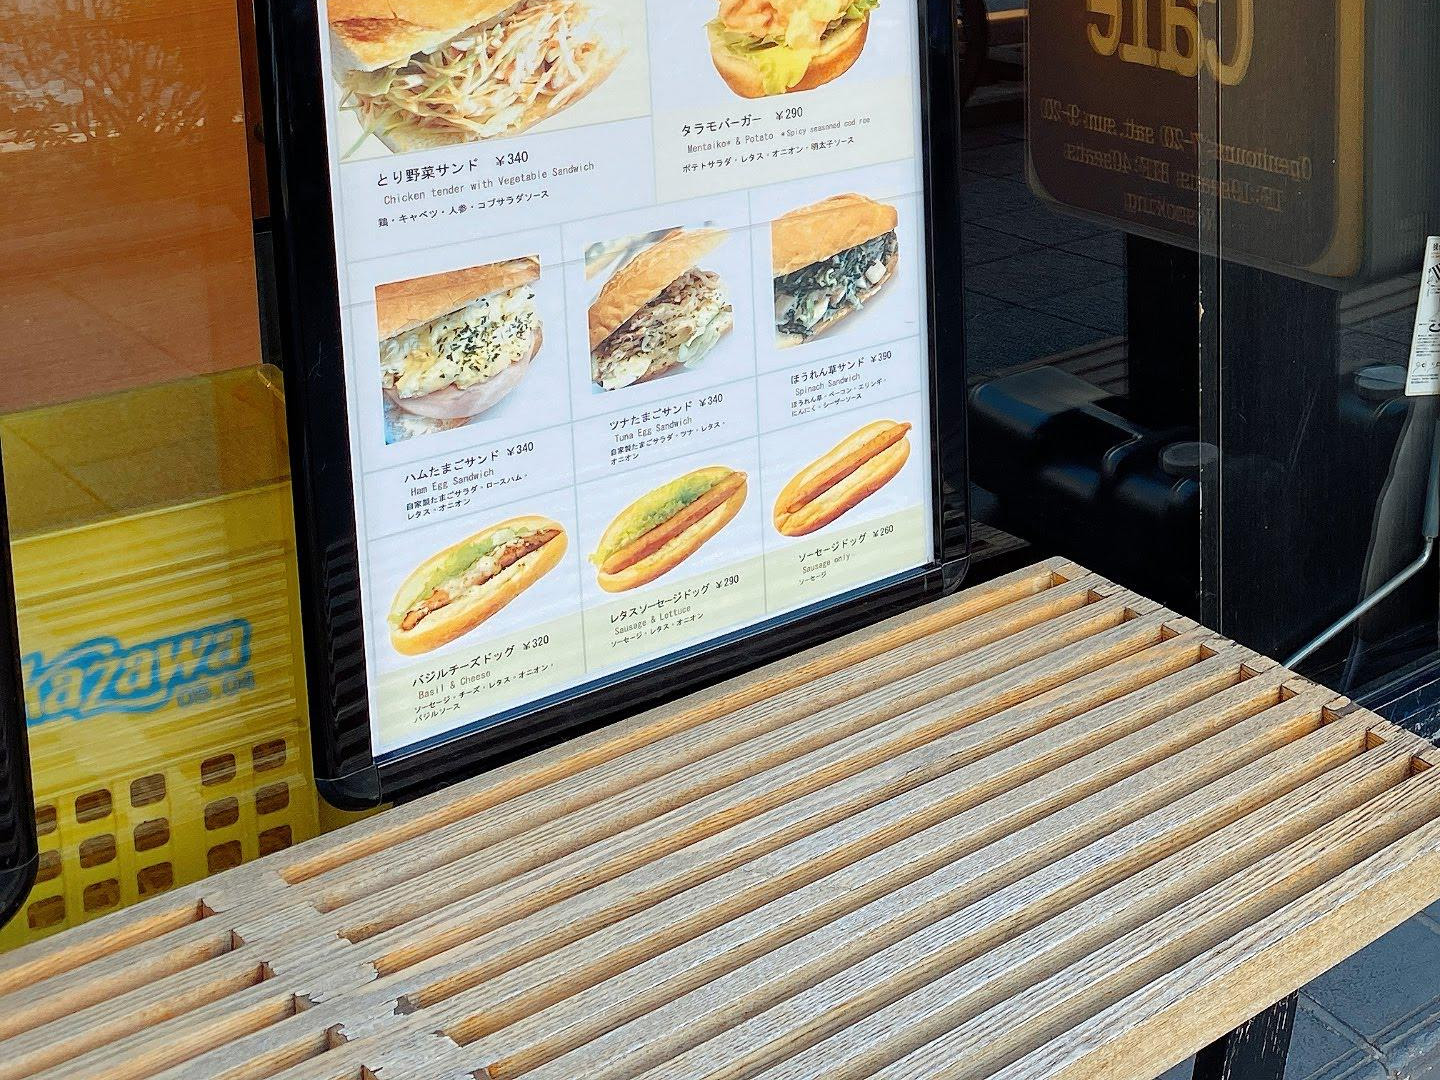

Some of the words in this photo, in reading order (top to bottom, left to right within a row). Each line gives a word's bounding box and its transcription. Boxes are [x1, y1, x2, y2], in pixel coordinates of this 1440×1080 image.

[681, 113, 762, 137] タラモバーガー
[775, 106, 804, 121] ¥290
[735, 136, 741, 146] &
[745, 131, 774, 145] Potato
[843, 118, 856, 128] cod
[377, 158, 479, 188] とり野菜サンド
[495, 150, 529, 167] ¥340
[383, 190, 426, 206] Chicken
[432, 183, 465, 198] tender
[470, 178, 494, 192] with
[498, 170, 548, 187] Vegetable
[552, 160, 595, 178] Sandwich
[790, 356, 865, 385] ほうれん草サンド
[795, 383, 825, 397] Spinach
[827, 373, 861, 387] Sandwich
[609, 400, 693, 431] ツナたまごサンド
[699, 393, 723, 407] ¥340
[614, 433, 634, 443] Tuna
[637, 427, 652, 438] Egg
[655, 416, 693, 433] Sandwich
[404, 450, 500, 483] ハムたまごサンド
[506, 441, 535, 457] ¥340
[610, 453, 639, 466] オニオン
[410, 486, 428, 497] Ham
[431, 480, 449, 491] Egg
[452, 468, 494, 486] Sandwich
[407, 497, 471, 520] レタス・オニオン
[798, 531, 867, 563] ソーセージドッグ
[798, 570, 827, 586] ソーセージ
[802, 559, 831, 574] Sausage
[610, 582, 710, 624] レタスソーセージドッグ
[715, 574, 740, 589] ¥290
[614, 619, 647, 636] Sausage
[650, 615, 657, 624] &
[659, 605, 691, 621] Lettuce
[412, 644, 515, 687] バジルチーズドッグ
[522, 634, 550, 650] ¥320
[418, 685, 445, 700] Basil
[449, 680, 456, 690] &
[460, 670, 491, 686] Cheese
[413, 702, 461, 724] バジルソース
